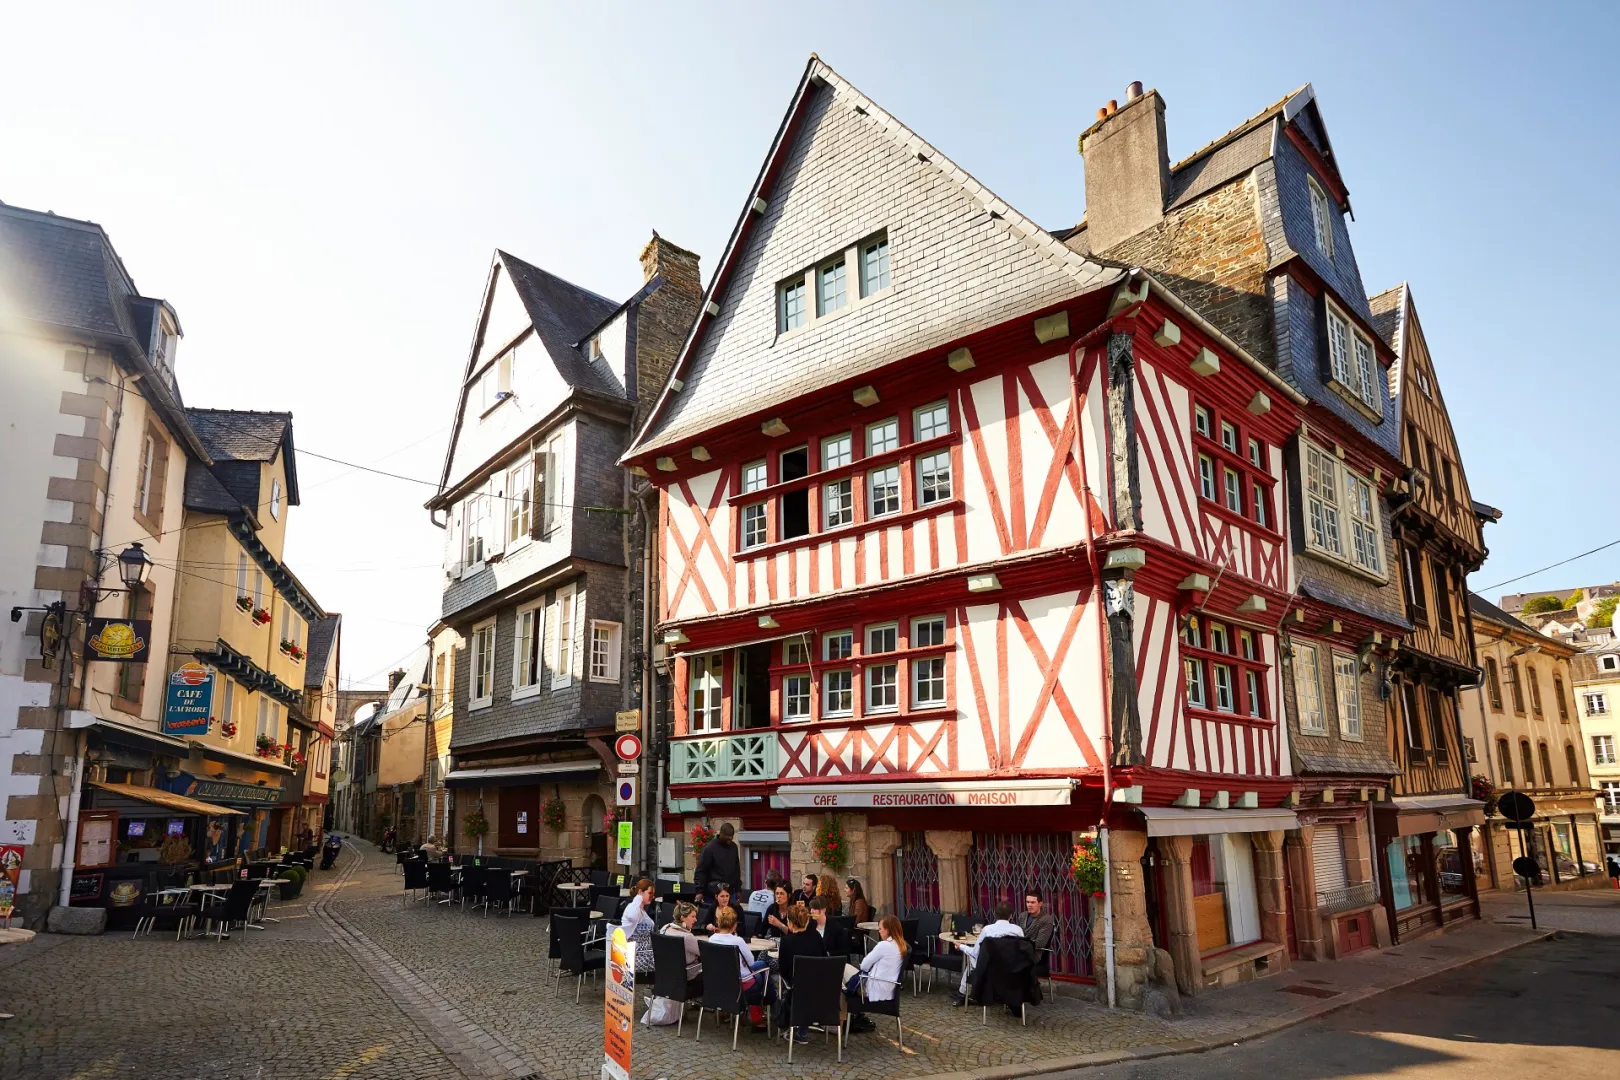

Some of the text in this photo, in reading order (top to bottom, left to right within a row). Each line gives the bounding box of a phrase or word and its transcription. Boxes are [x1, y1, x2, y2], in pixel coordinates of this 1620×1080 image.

[94, 642, 140, 653] GRIMBERGEN
[176, 689, 204, 699] CAFE
[168, 705, 208, 713] L'AURORE
[813, 792, 1017, 806] CAFE RESTAURATION MAISON
